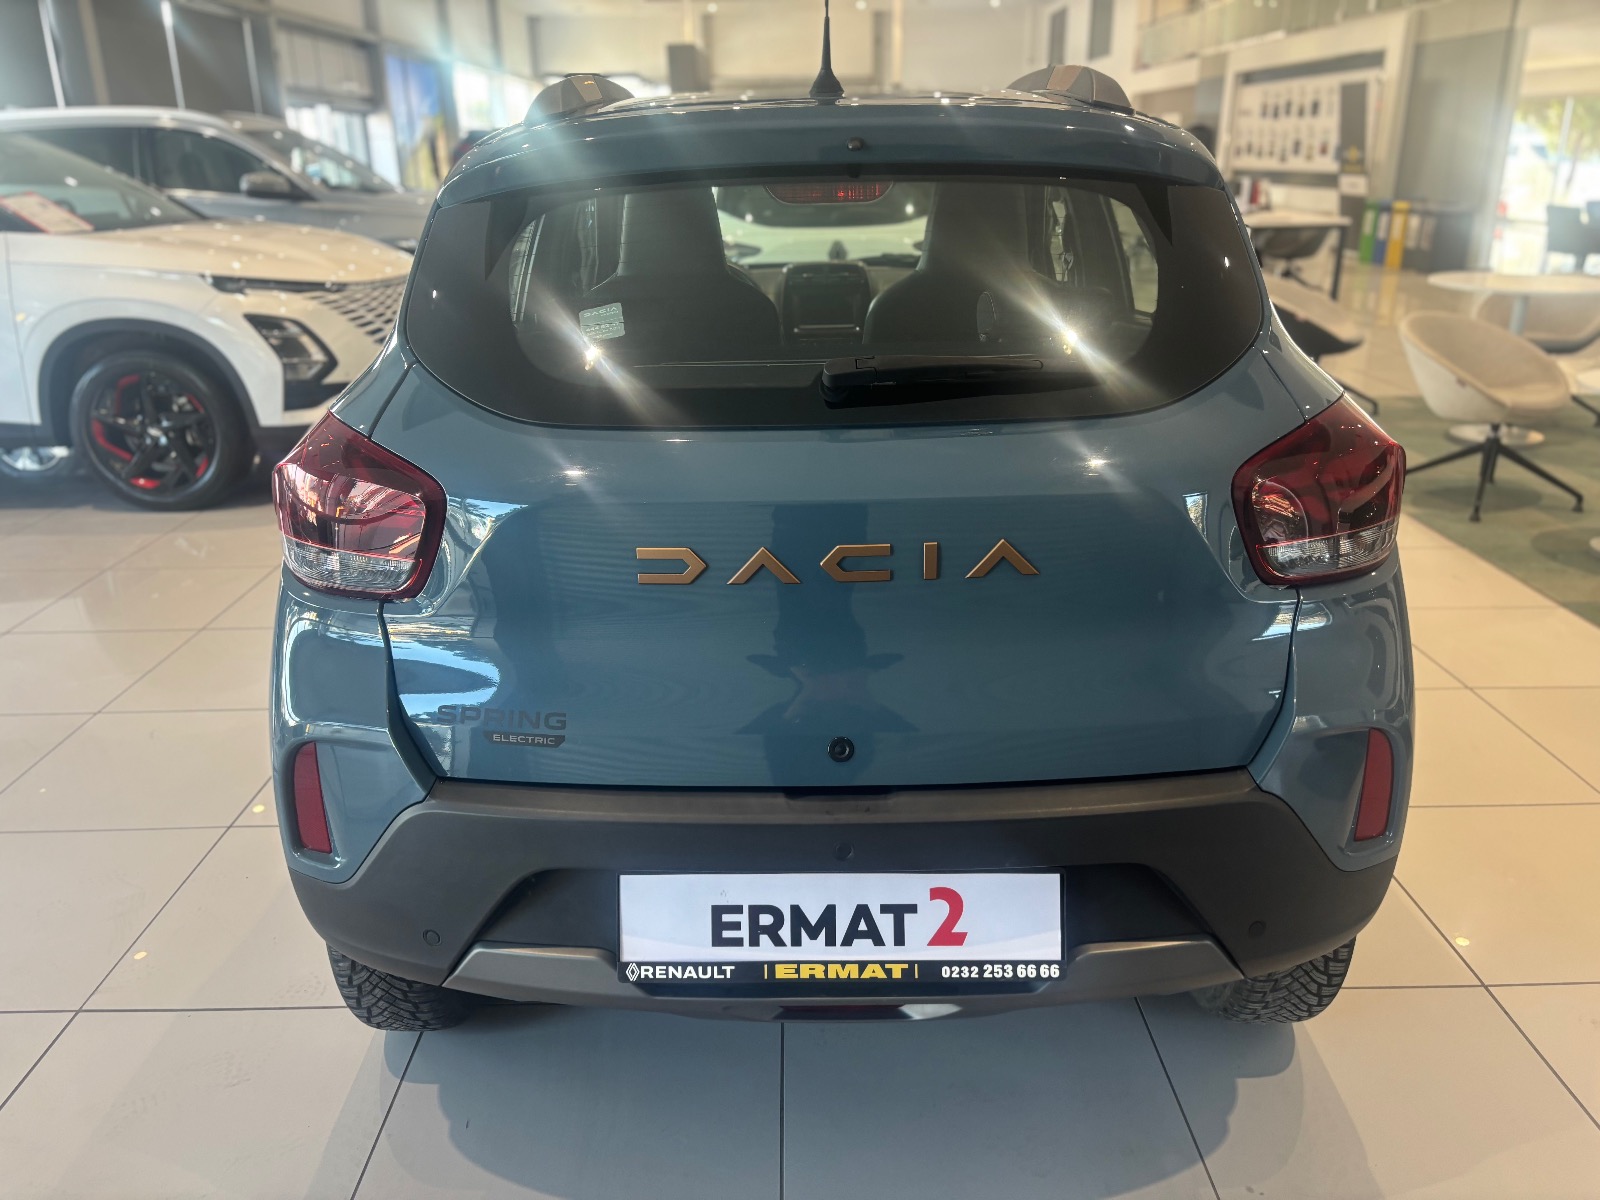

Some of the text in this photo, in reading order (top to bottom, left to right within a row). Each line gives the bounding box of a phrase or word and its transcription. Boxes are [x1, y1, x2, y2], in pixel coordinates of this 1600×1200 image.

[636, 538, 1040, 585] DACIA
[437, 704, 567, 731] SPRING
[492, 734, 556, 745] ELECTRIC
[710, 886, 969, 947] ERMAT 2
[640, 965, 736, 979] RENAULT
[774, 963, 909, 979] ERMAT
[941, 963, 1061, 979] 0232 253 66 66
